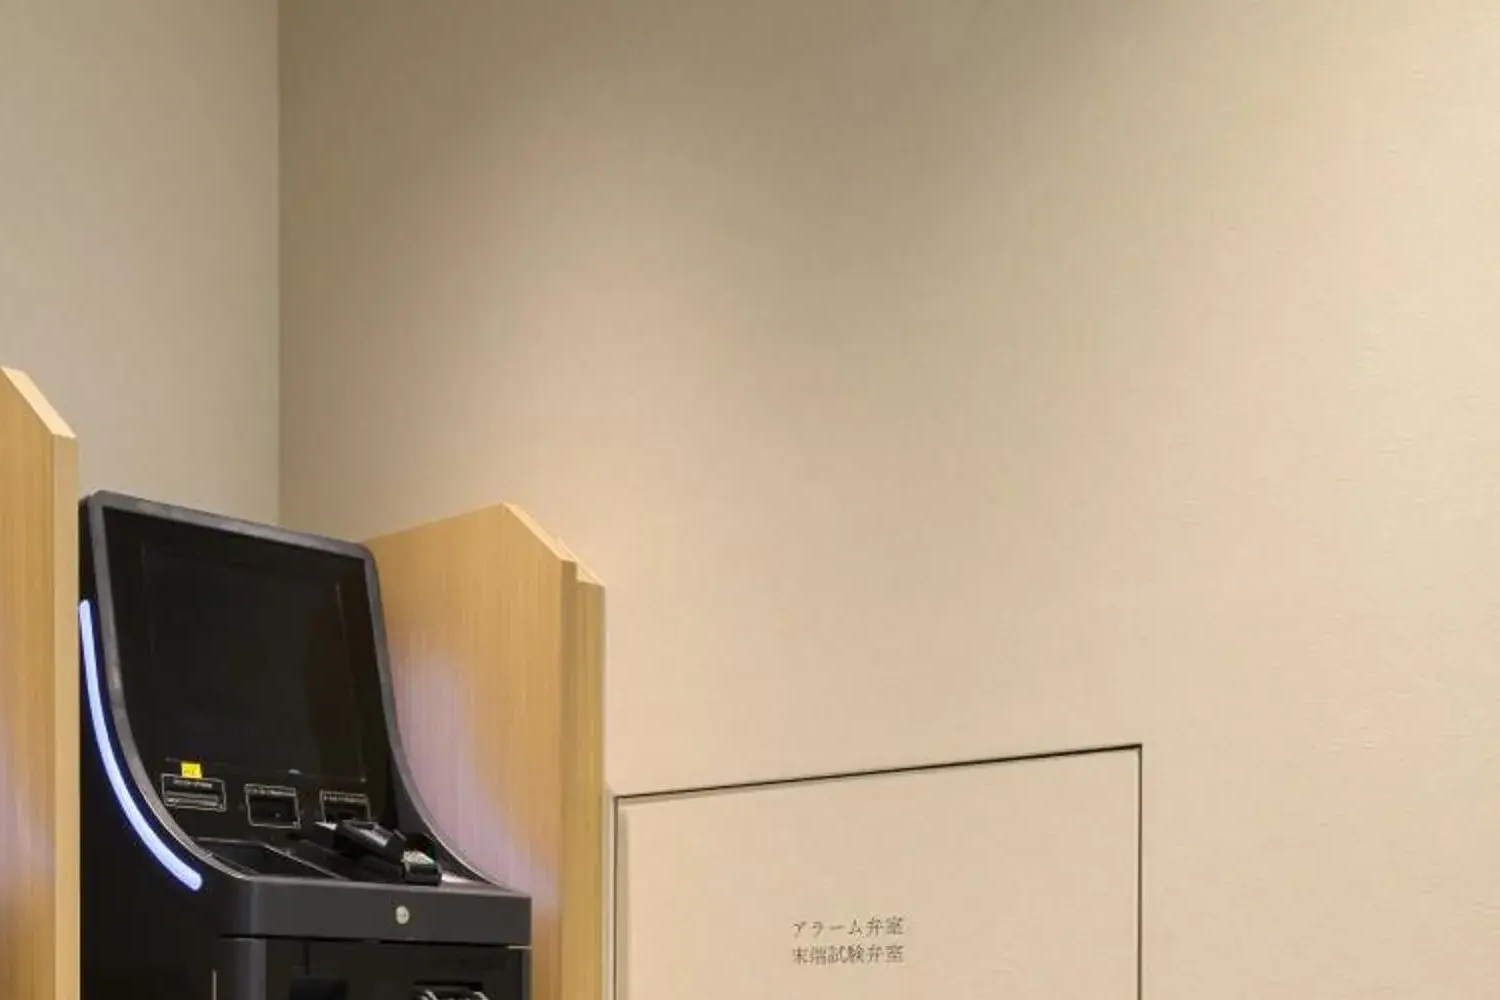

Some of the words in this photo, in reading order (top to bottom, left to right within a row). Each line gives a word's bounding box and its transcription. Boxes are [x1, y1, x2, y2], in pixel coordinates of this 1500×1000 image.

[791, 916, 904, 938] アラーム弁室
